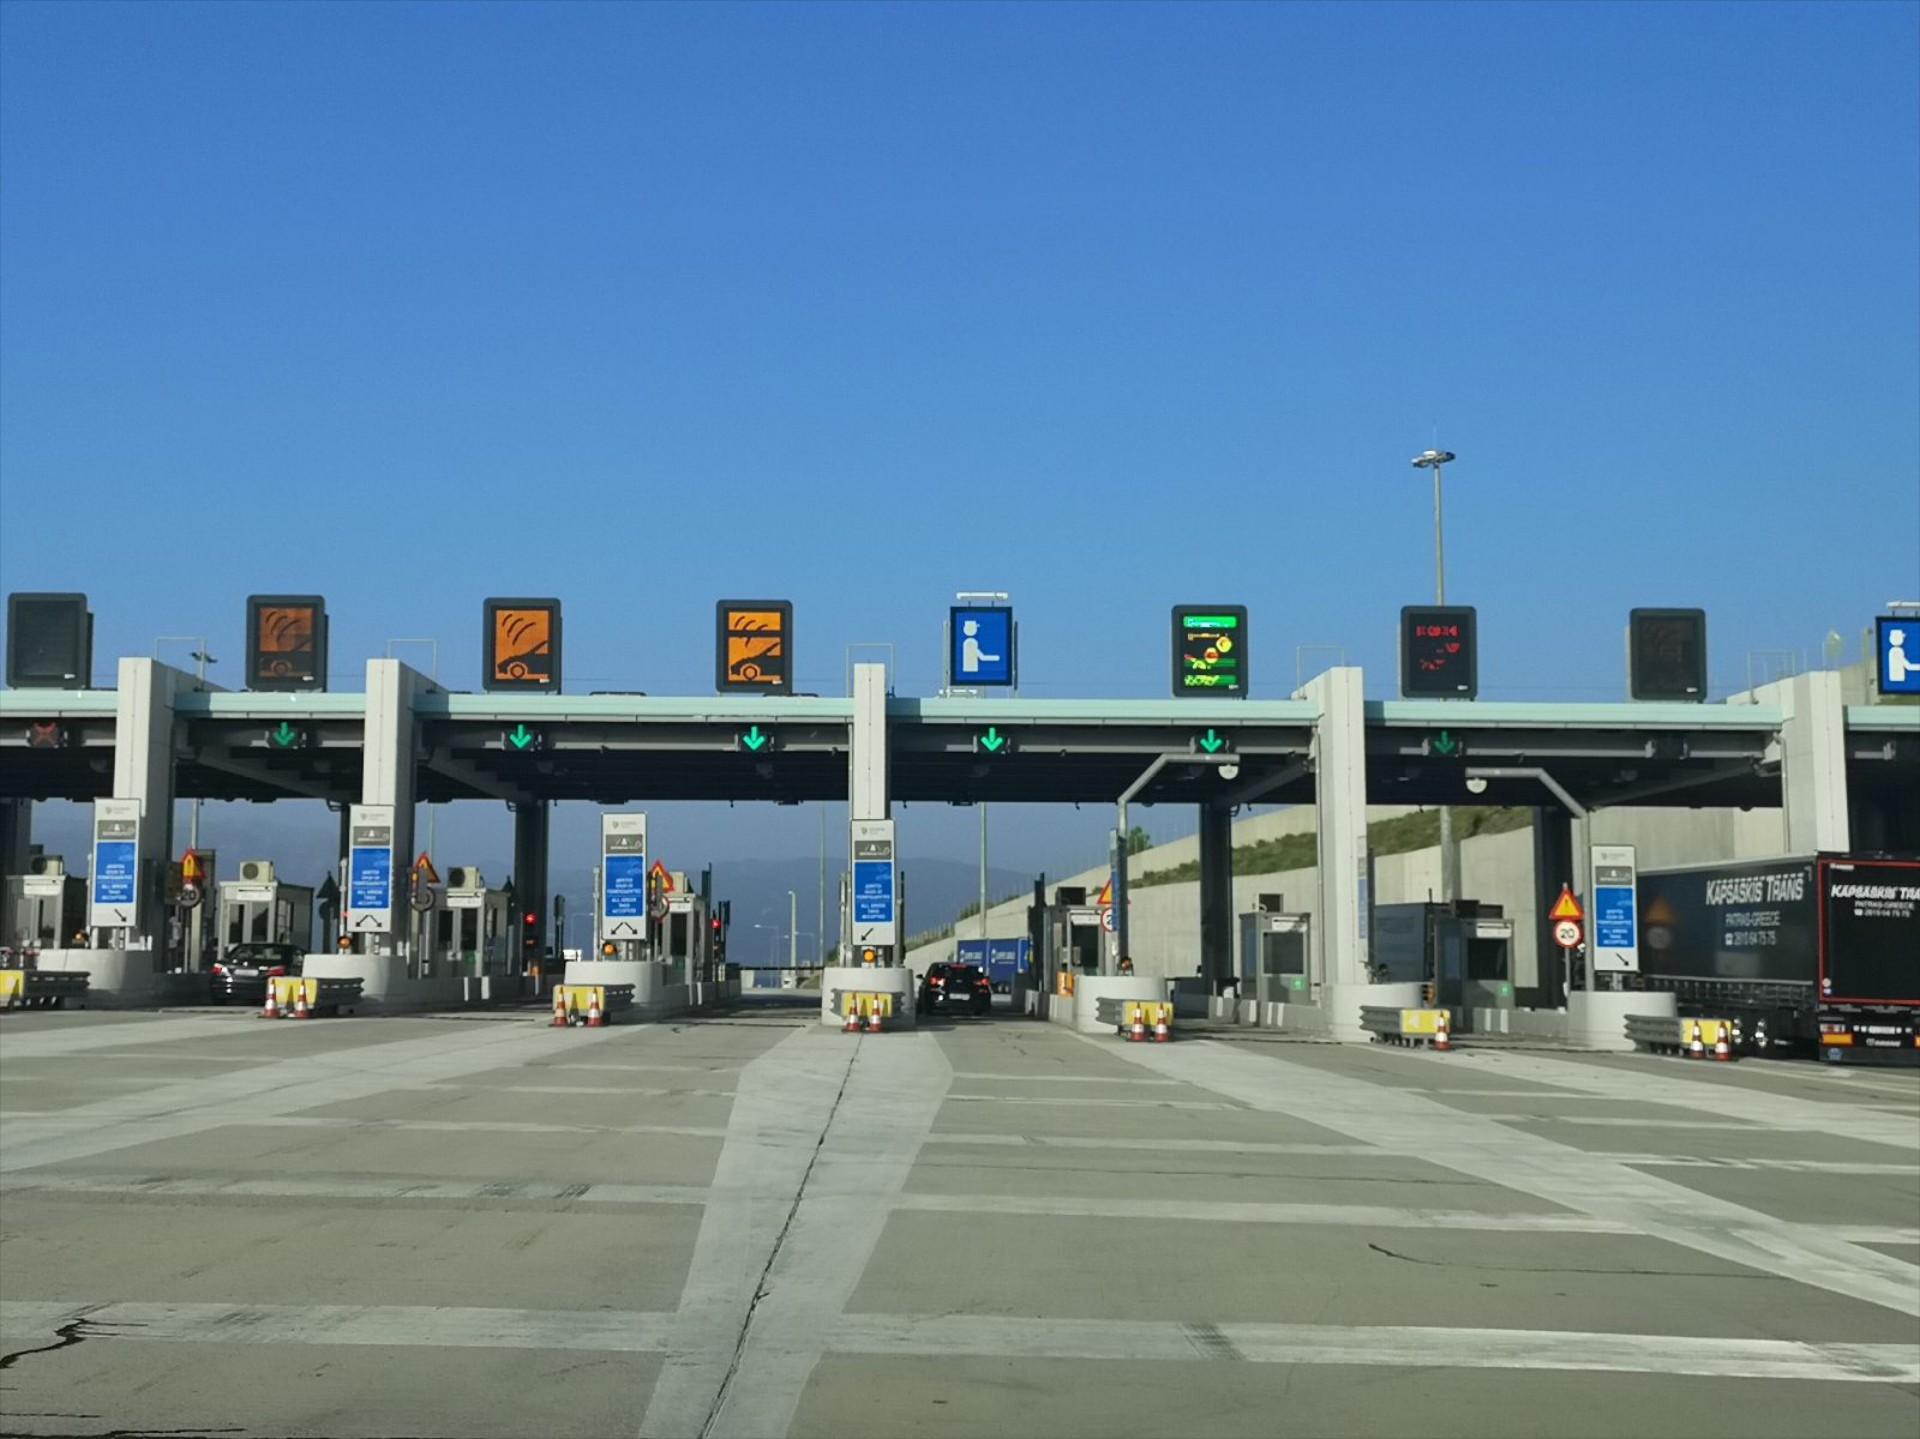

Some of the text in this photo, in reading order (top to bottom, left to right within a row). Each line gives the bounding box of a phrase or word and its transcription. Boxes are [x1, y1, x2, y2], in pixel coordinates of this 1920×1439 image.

[180, 889, 196, 901] 20
[1705, 875, 1804, 905] KAPSASKIS TRANS
[1560, 928, 1575, 940] 20
